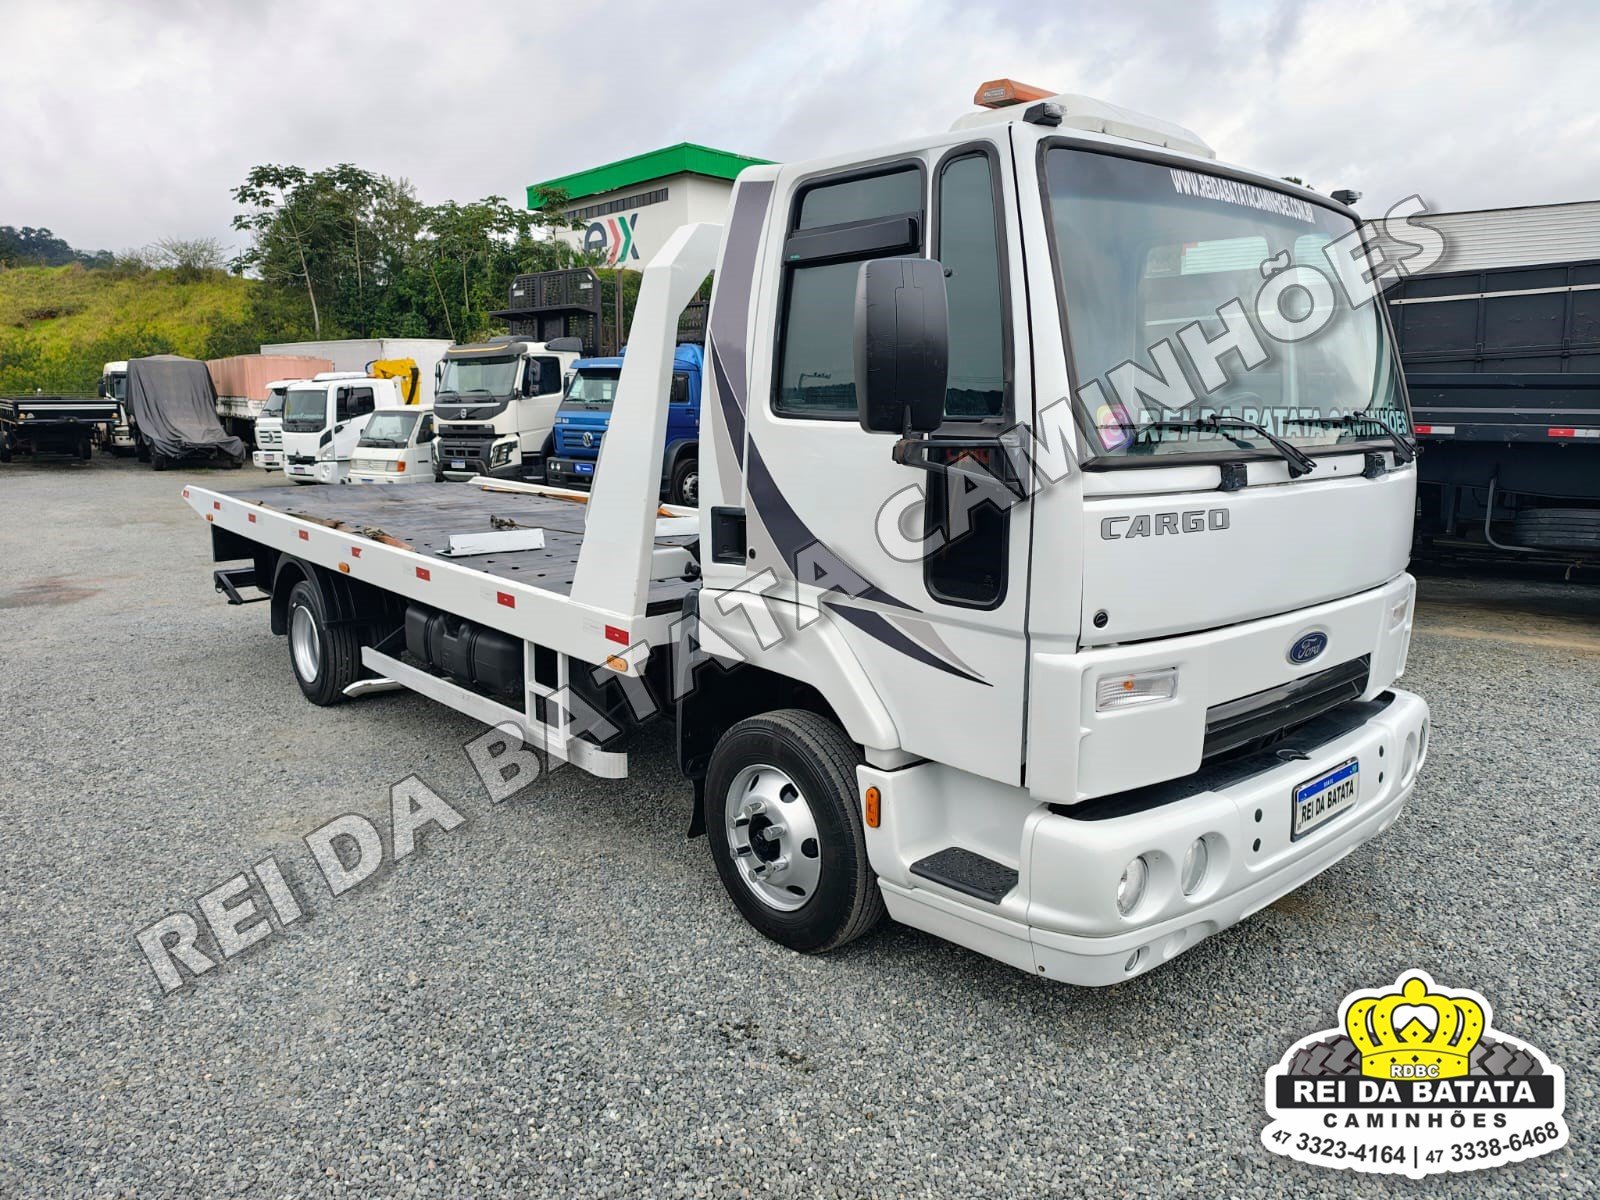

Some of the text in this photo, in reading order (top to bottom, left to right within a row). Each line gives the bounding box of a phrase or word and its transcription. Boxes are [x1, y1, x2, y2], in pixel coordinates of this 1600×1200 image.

[1138, 407, 1191, 443] REI
[1240, 405, 1323, 440] BATATA
[1100, 507, 1231, 541] CARGO
[1297, 637, 1324, 660] Ford
[1301, 801, 1314, 825] REI
[1315, 795, 1326, 815] DA
[1327, 779, 1354, 808] BATATA
